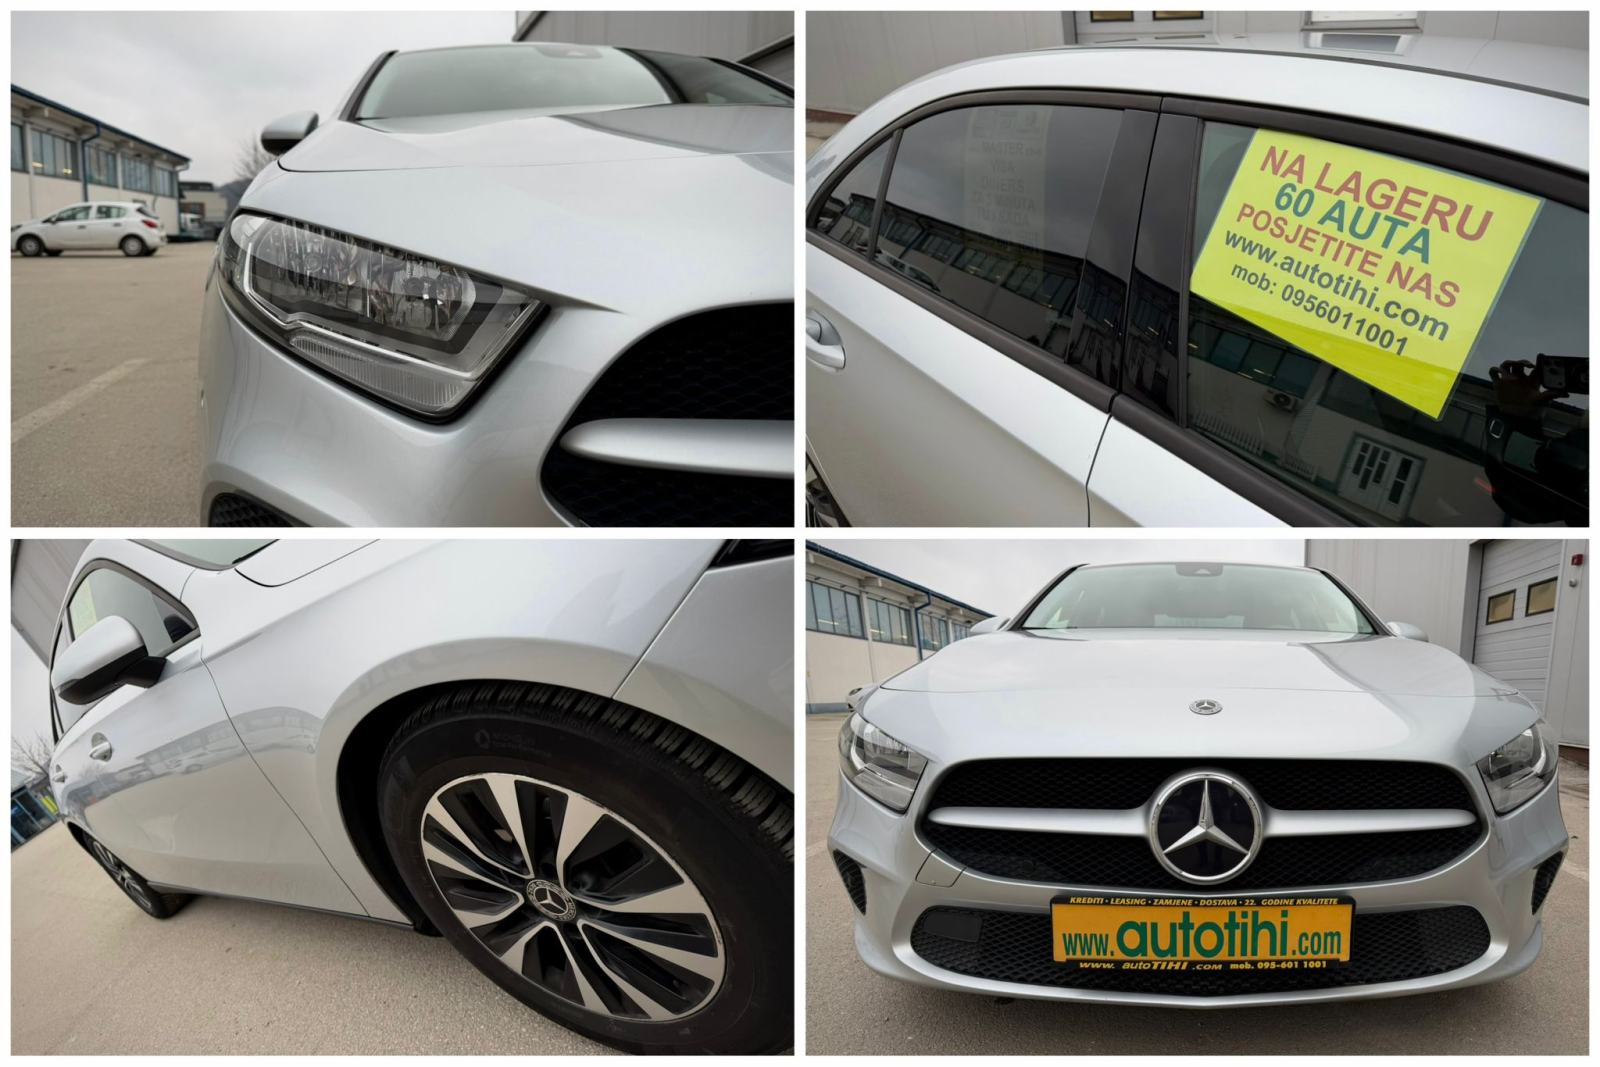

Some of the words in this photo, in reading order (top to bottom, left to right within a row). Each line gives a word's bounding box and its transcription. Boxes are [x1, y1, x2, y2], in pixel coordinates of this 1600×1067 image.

[1259, 145, 1305, 184] NA
[1314, 162, 1494, 241] LAGERU
[1274, 182, 1315, 218] 60
[1318, 199, 1431, 264] AUTA
[1225, 230, 1449, 341] www.autotihi.com
[1236, 203, 1383, 277] POSJETITE
[1386, 261, 1461, 308] NAS
[1231, 263, 1275, 295] mob:
[1281, 284, 1409, 356] 0956011001
[1070, 896, 1104, 905] KREDITI
[1110, 897, 1146, 906] LEASING
[1153, 898, 1193, 906] ZAMJENE
[1261, 898, 1294, 906] GODINE
[1230, 961, 1255, 969] mob.
[1257, 961, 1299, 969] 095-601
[1303, 960, 1327, 968] 1001
